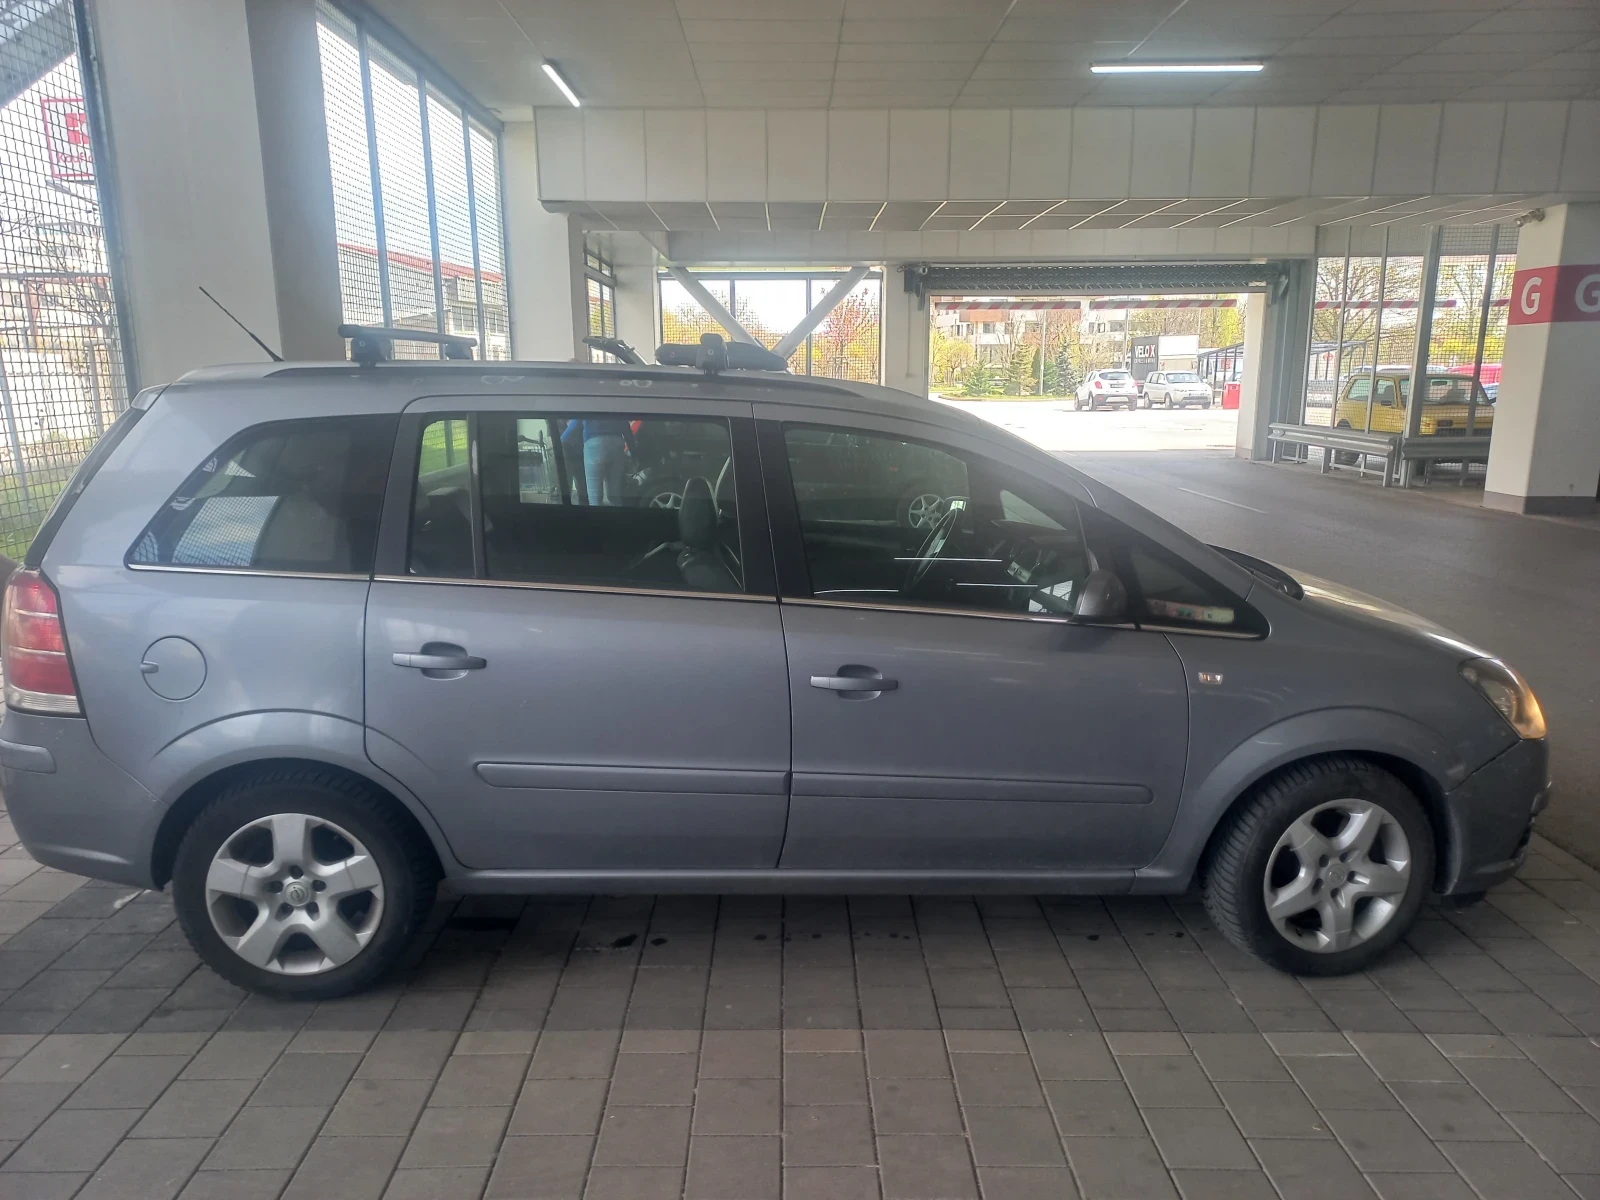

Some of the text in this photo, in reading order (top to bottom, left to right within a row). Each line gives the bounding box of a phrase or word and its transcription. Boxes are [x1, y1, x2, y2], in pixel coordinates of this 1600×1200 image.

[1521, 276, 1542, 315] G
[1575, 273, 1600, 313] G
[1134, 344, 1156, 358] VELOX
